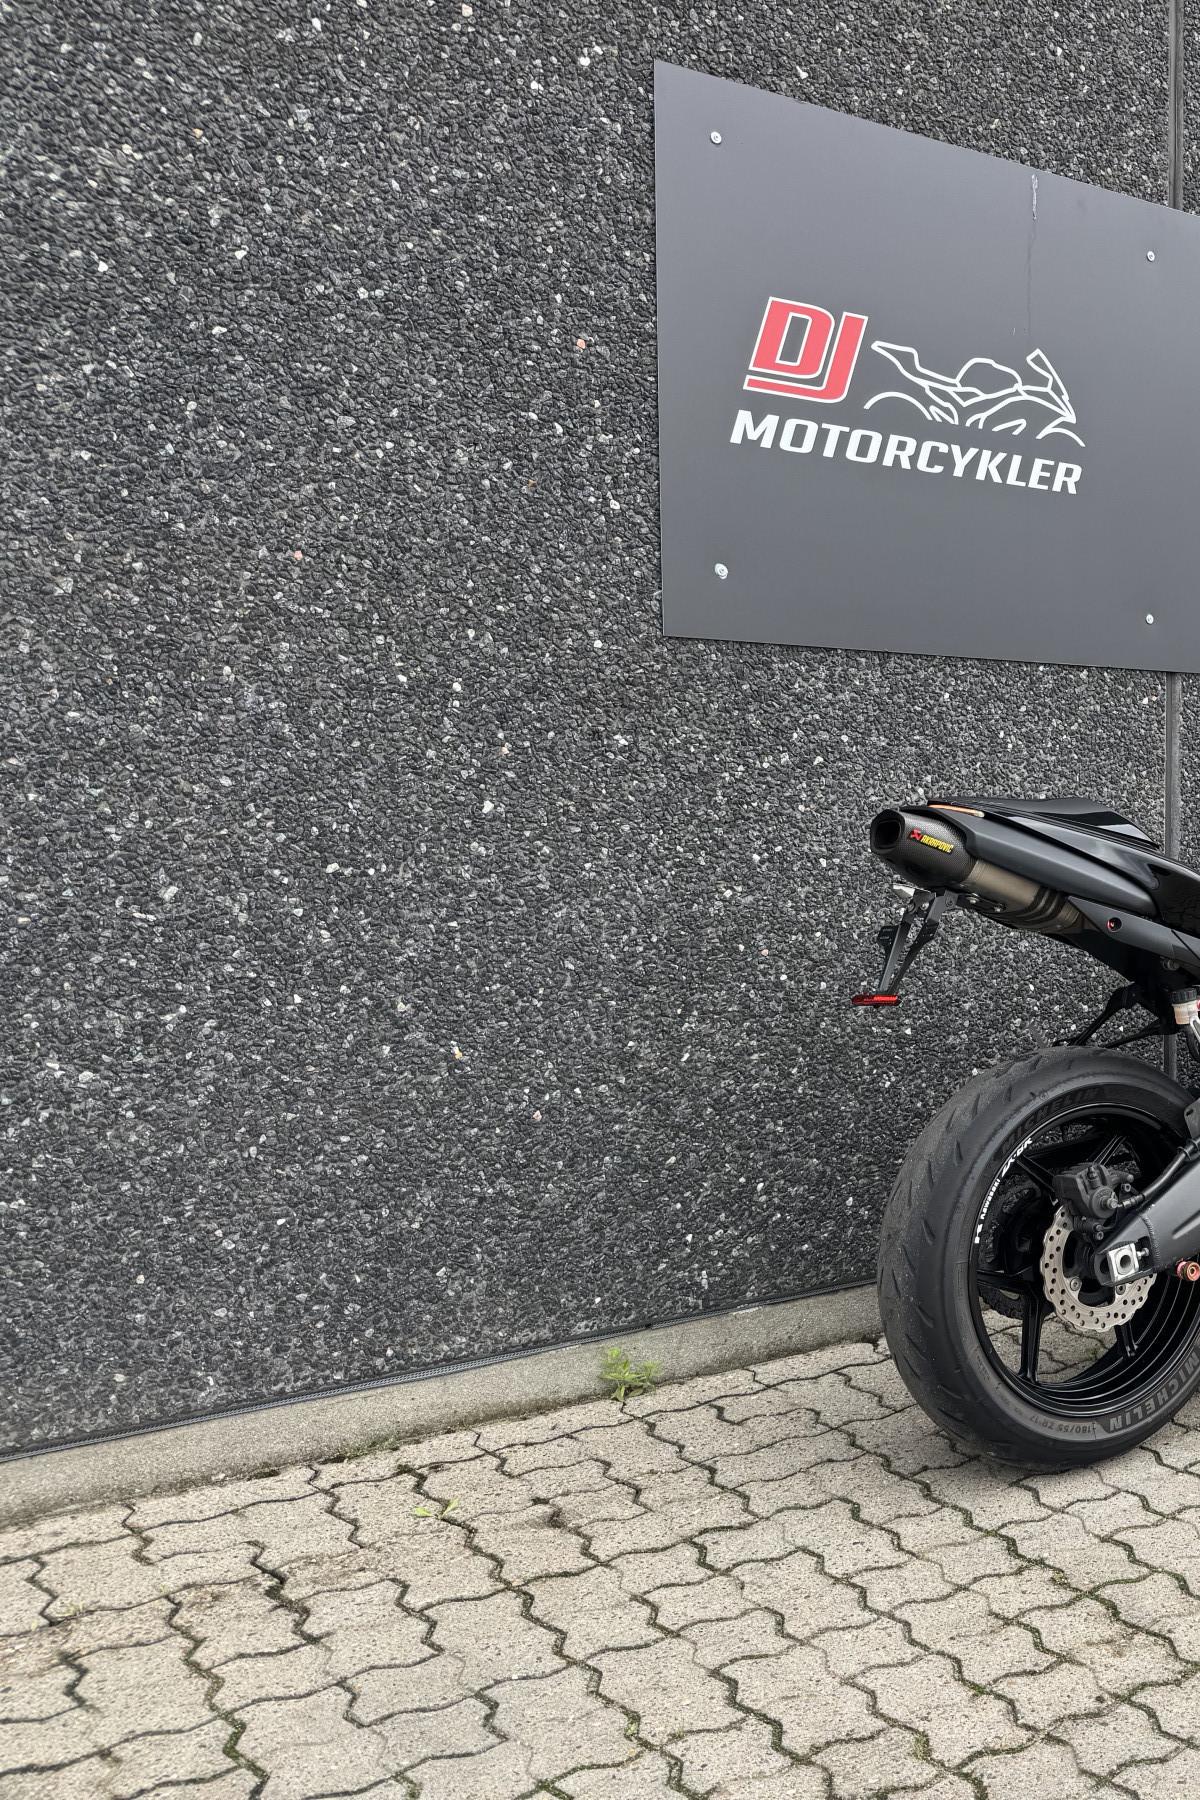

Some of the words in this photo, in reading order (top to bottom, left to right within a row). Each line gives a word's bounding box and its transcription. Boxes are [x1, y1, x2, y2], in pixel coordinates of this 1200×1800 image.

[742, 296, 868, 403] DJ
[729, 409, 1083, 494] MOTORCYKLER
[1109, 1351, 1200, 1432] MICHELIN
